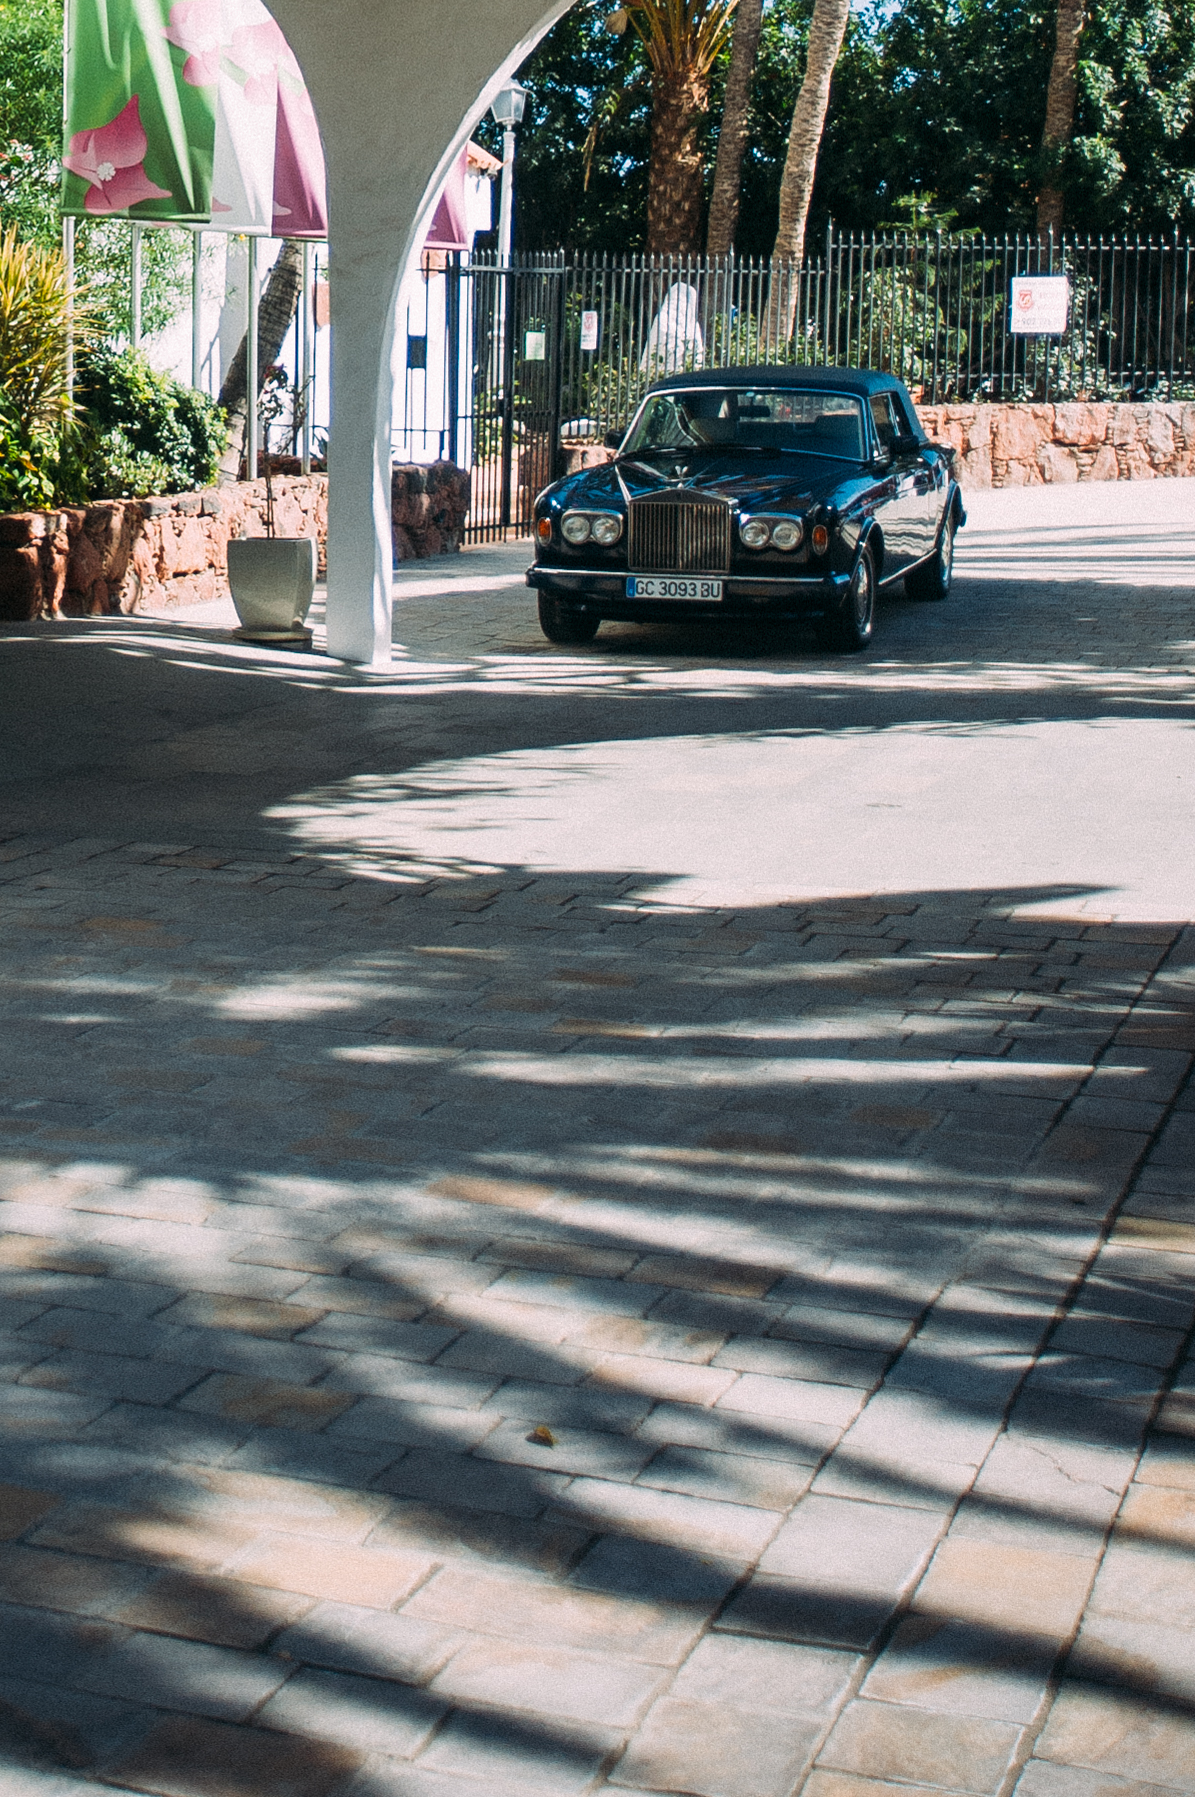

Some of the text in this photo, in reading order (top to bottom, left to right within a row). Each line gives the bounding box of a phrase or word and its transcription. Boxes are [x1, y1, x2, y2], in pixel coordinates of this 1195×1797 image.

[635, 580, 720, 598] GC 3093 BU
